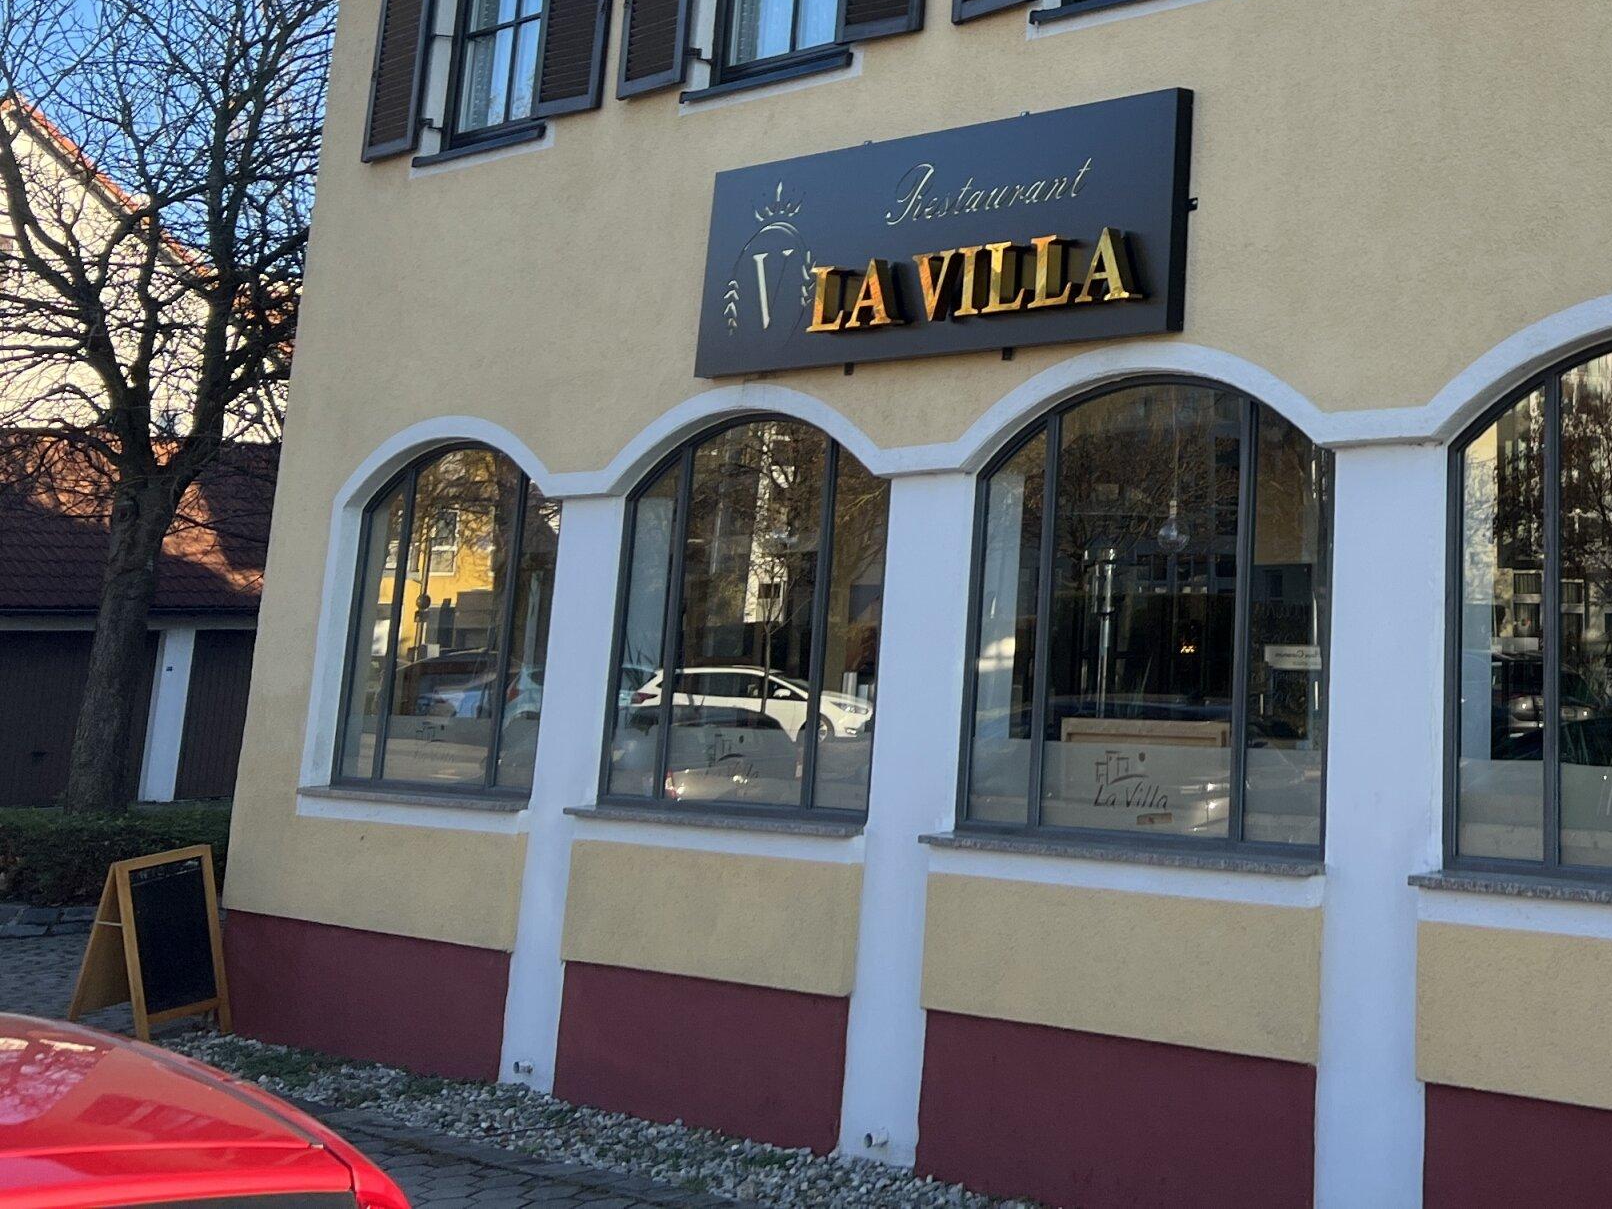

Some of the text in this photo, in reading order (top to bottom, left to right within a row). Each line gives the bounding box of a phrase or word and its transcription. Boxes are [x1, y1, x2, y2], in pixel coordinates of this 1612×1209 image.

[885, 156, 1092, 226] Restaurant
[805, 226, 1143, 334] LA VILLA
[1094, 781, 1168, 810] La Villa
